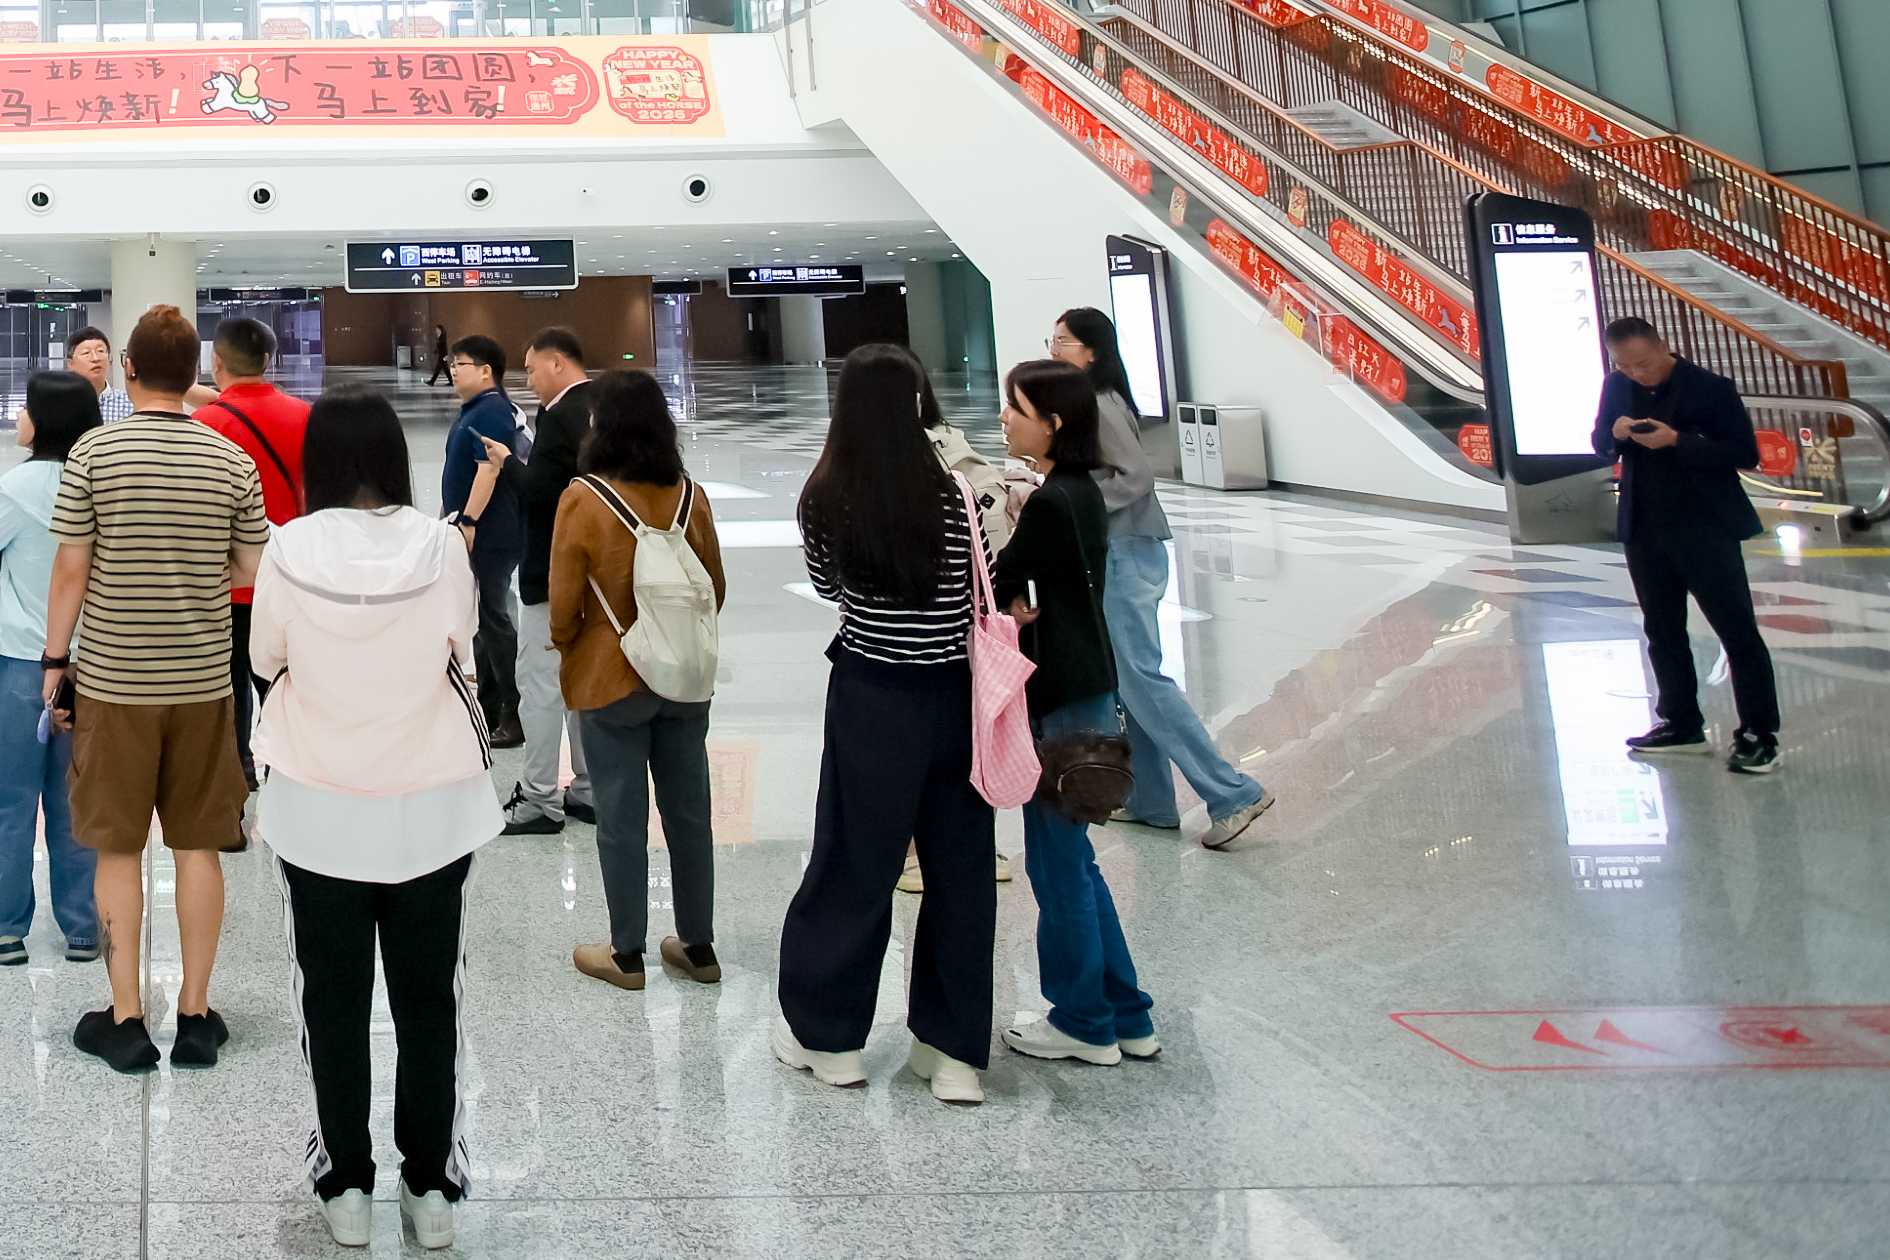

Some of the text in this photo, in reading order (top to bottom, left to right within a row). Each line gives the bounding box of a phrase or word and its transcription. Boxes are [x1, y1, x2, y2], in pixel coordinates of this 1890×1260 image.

[623, 51, 679, 59] HAPPY
[611, 60, 695, 68] NEW YEAR
[637, 110, 686, 119] 2026
[421, 246, 531, 257] 西停车场 无障碍电梯
[1338, 245, 1367, 271] 2026
[441, 272, 462, 280] 出租车
[1375, 248, 1435, 303] 新一站生活
